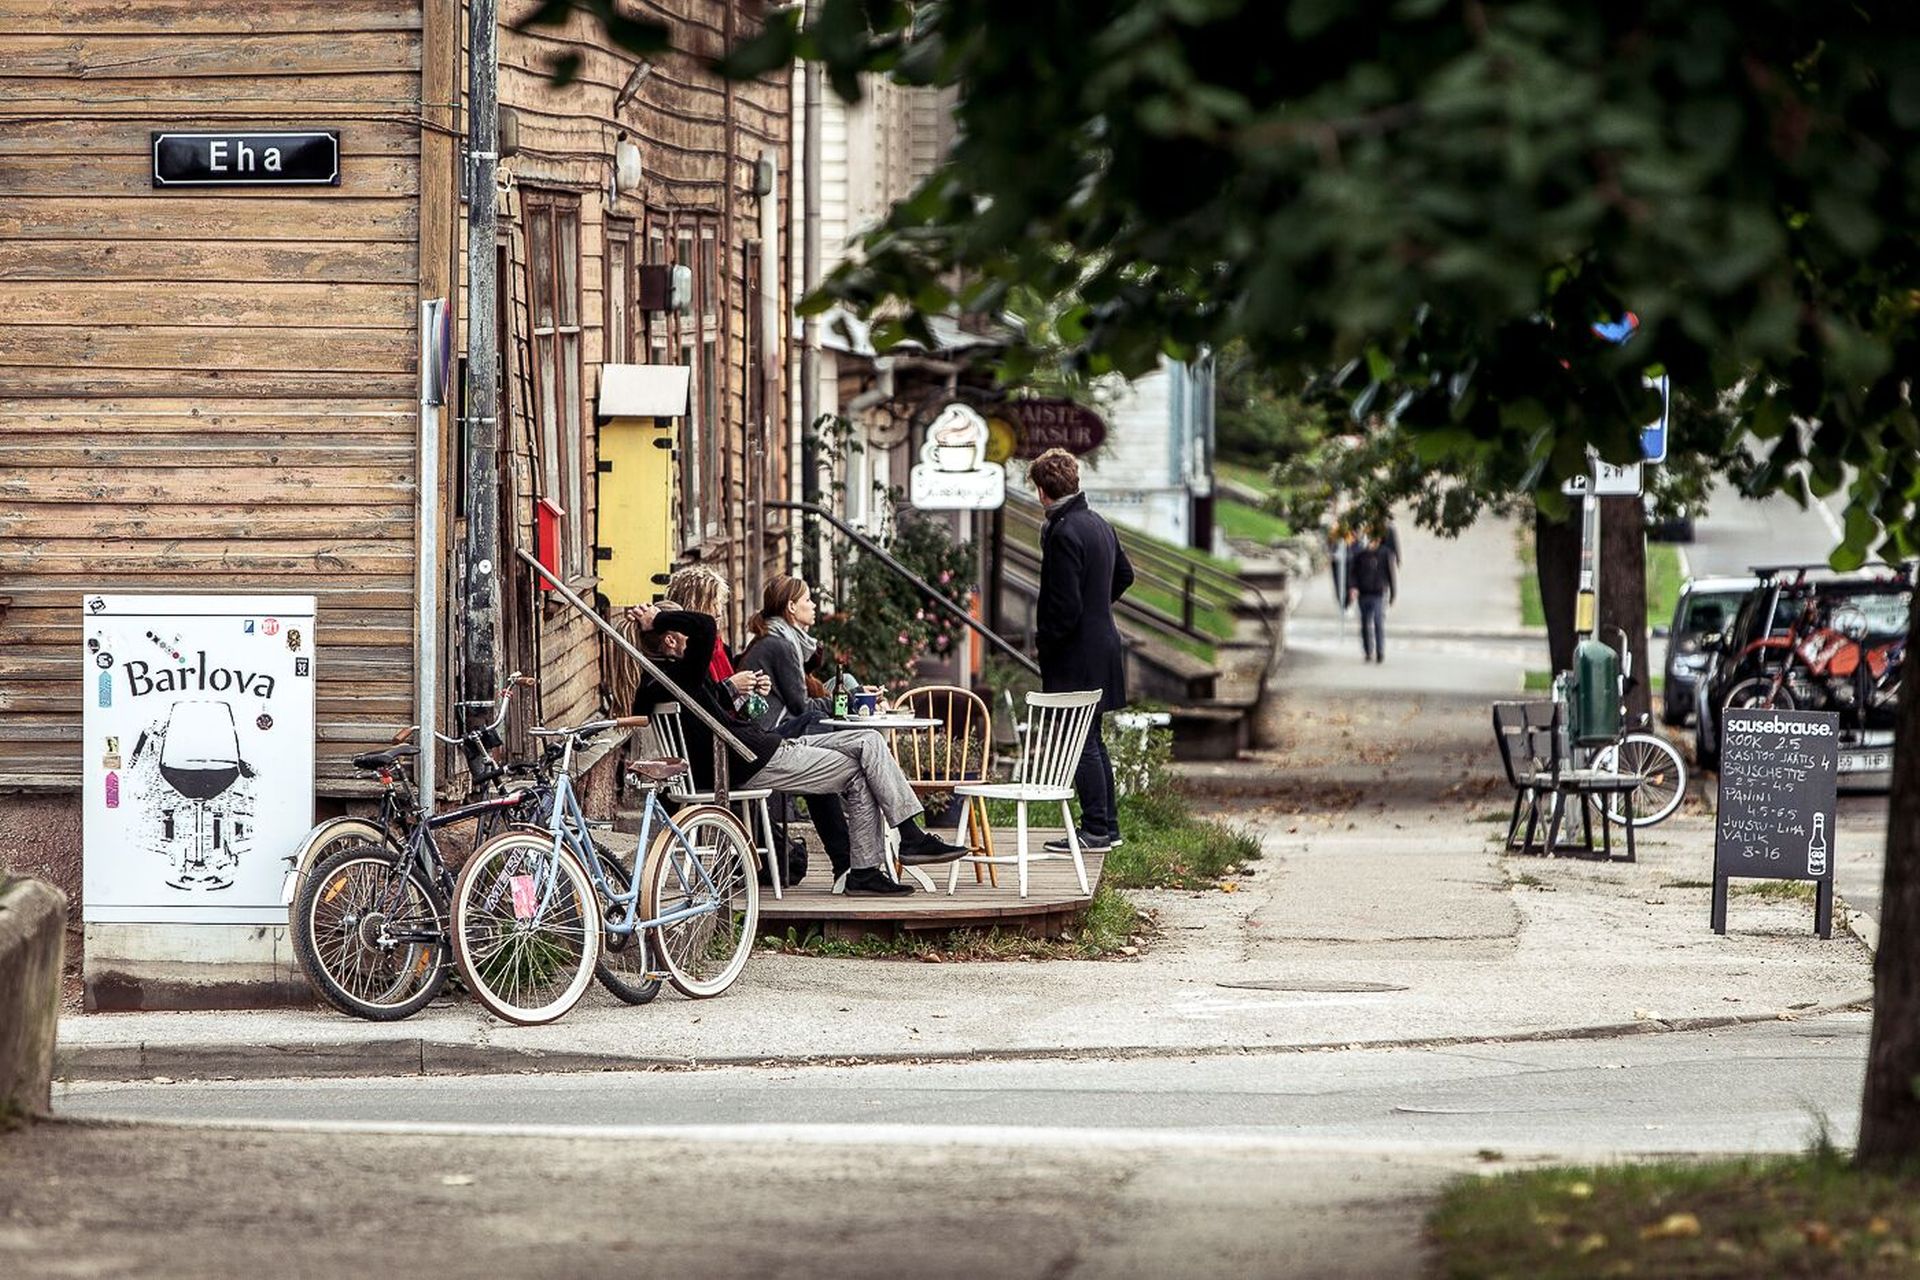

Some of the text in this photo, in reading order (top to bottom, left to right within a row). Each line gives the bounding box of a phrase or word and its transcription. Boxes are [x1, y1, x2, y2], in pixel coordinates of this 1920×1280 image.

[209, 141, 282, 172] Eha
[123, 651, 275, 699] Barlova
[1727, 714, 1834, 736] sausebrause.
[1725, 733, 1802, 750] KOOK 2.5
[1821, 753, 1831, 771] 4
[1723, 786, 1771, 805] PANINI
[1722, 829, 1769, 845] VALIK
